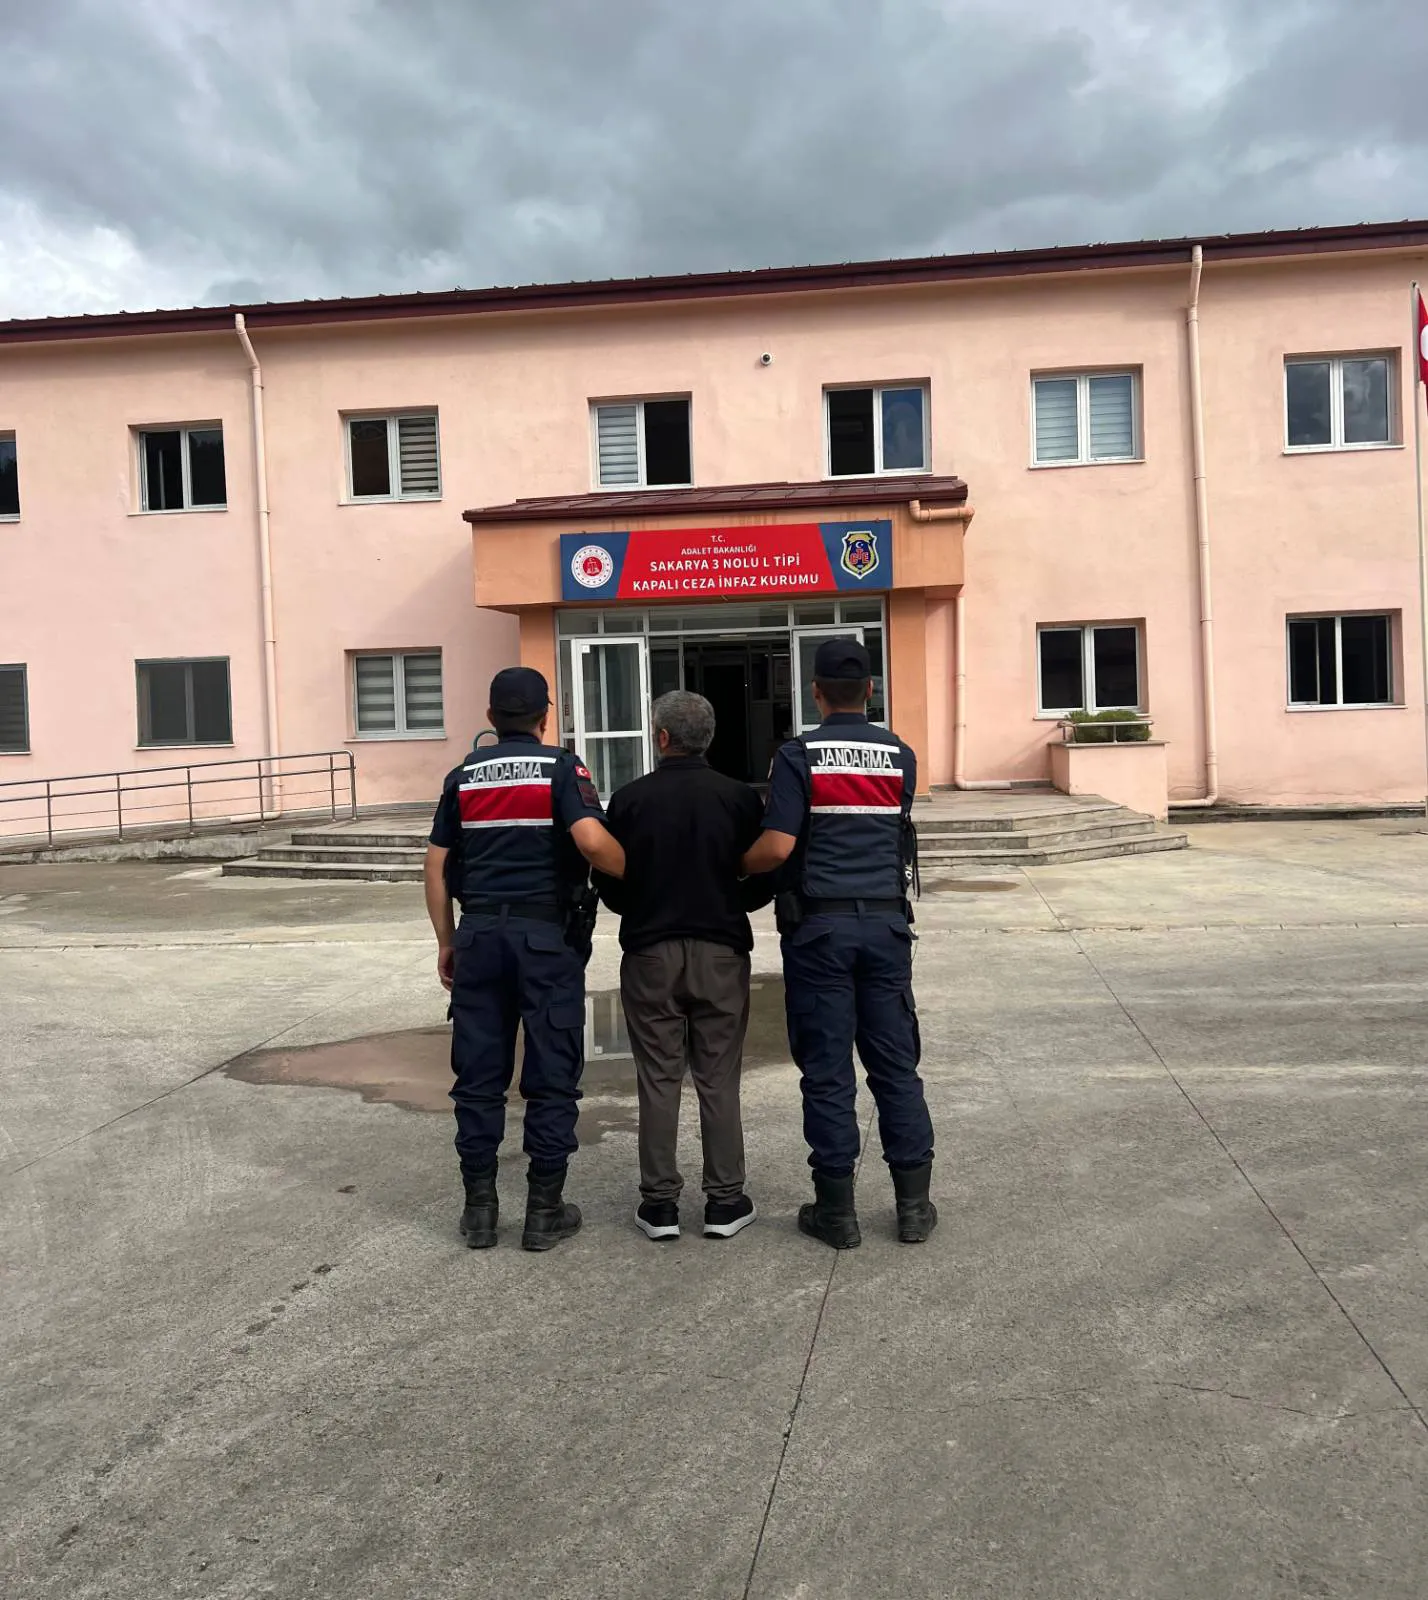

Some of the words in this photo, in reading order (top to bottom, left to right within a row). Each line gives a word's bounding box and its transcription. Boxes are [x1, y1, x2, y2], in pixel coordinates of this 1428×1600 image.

[681, 547, 712, 555] ADALET
[714, 544, 757, 554] BAKANLIĞI
[650, 560, 709, 572] SAKARYA
[712, 559, 719, 569] 3
[723, 558, 759, 569] NOLU
[763, 557, 770, 567] L
[773, 553, 800, 567] TİPİ
[633, 579, 679, 591] KAPALI
[682, 577, 715, 589] CEZA
[718, 575, 757, 587] İNFAZ
[761, 574, 820, 587] KURUMU
[817, 748, 893, 769] JANDARMA
[468, 763, 542, 784] JANDARMA
